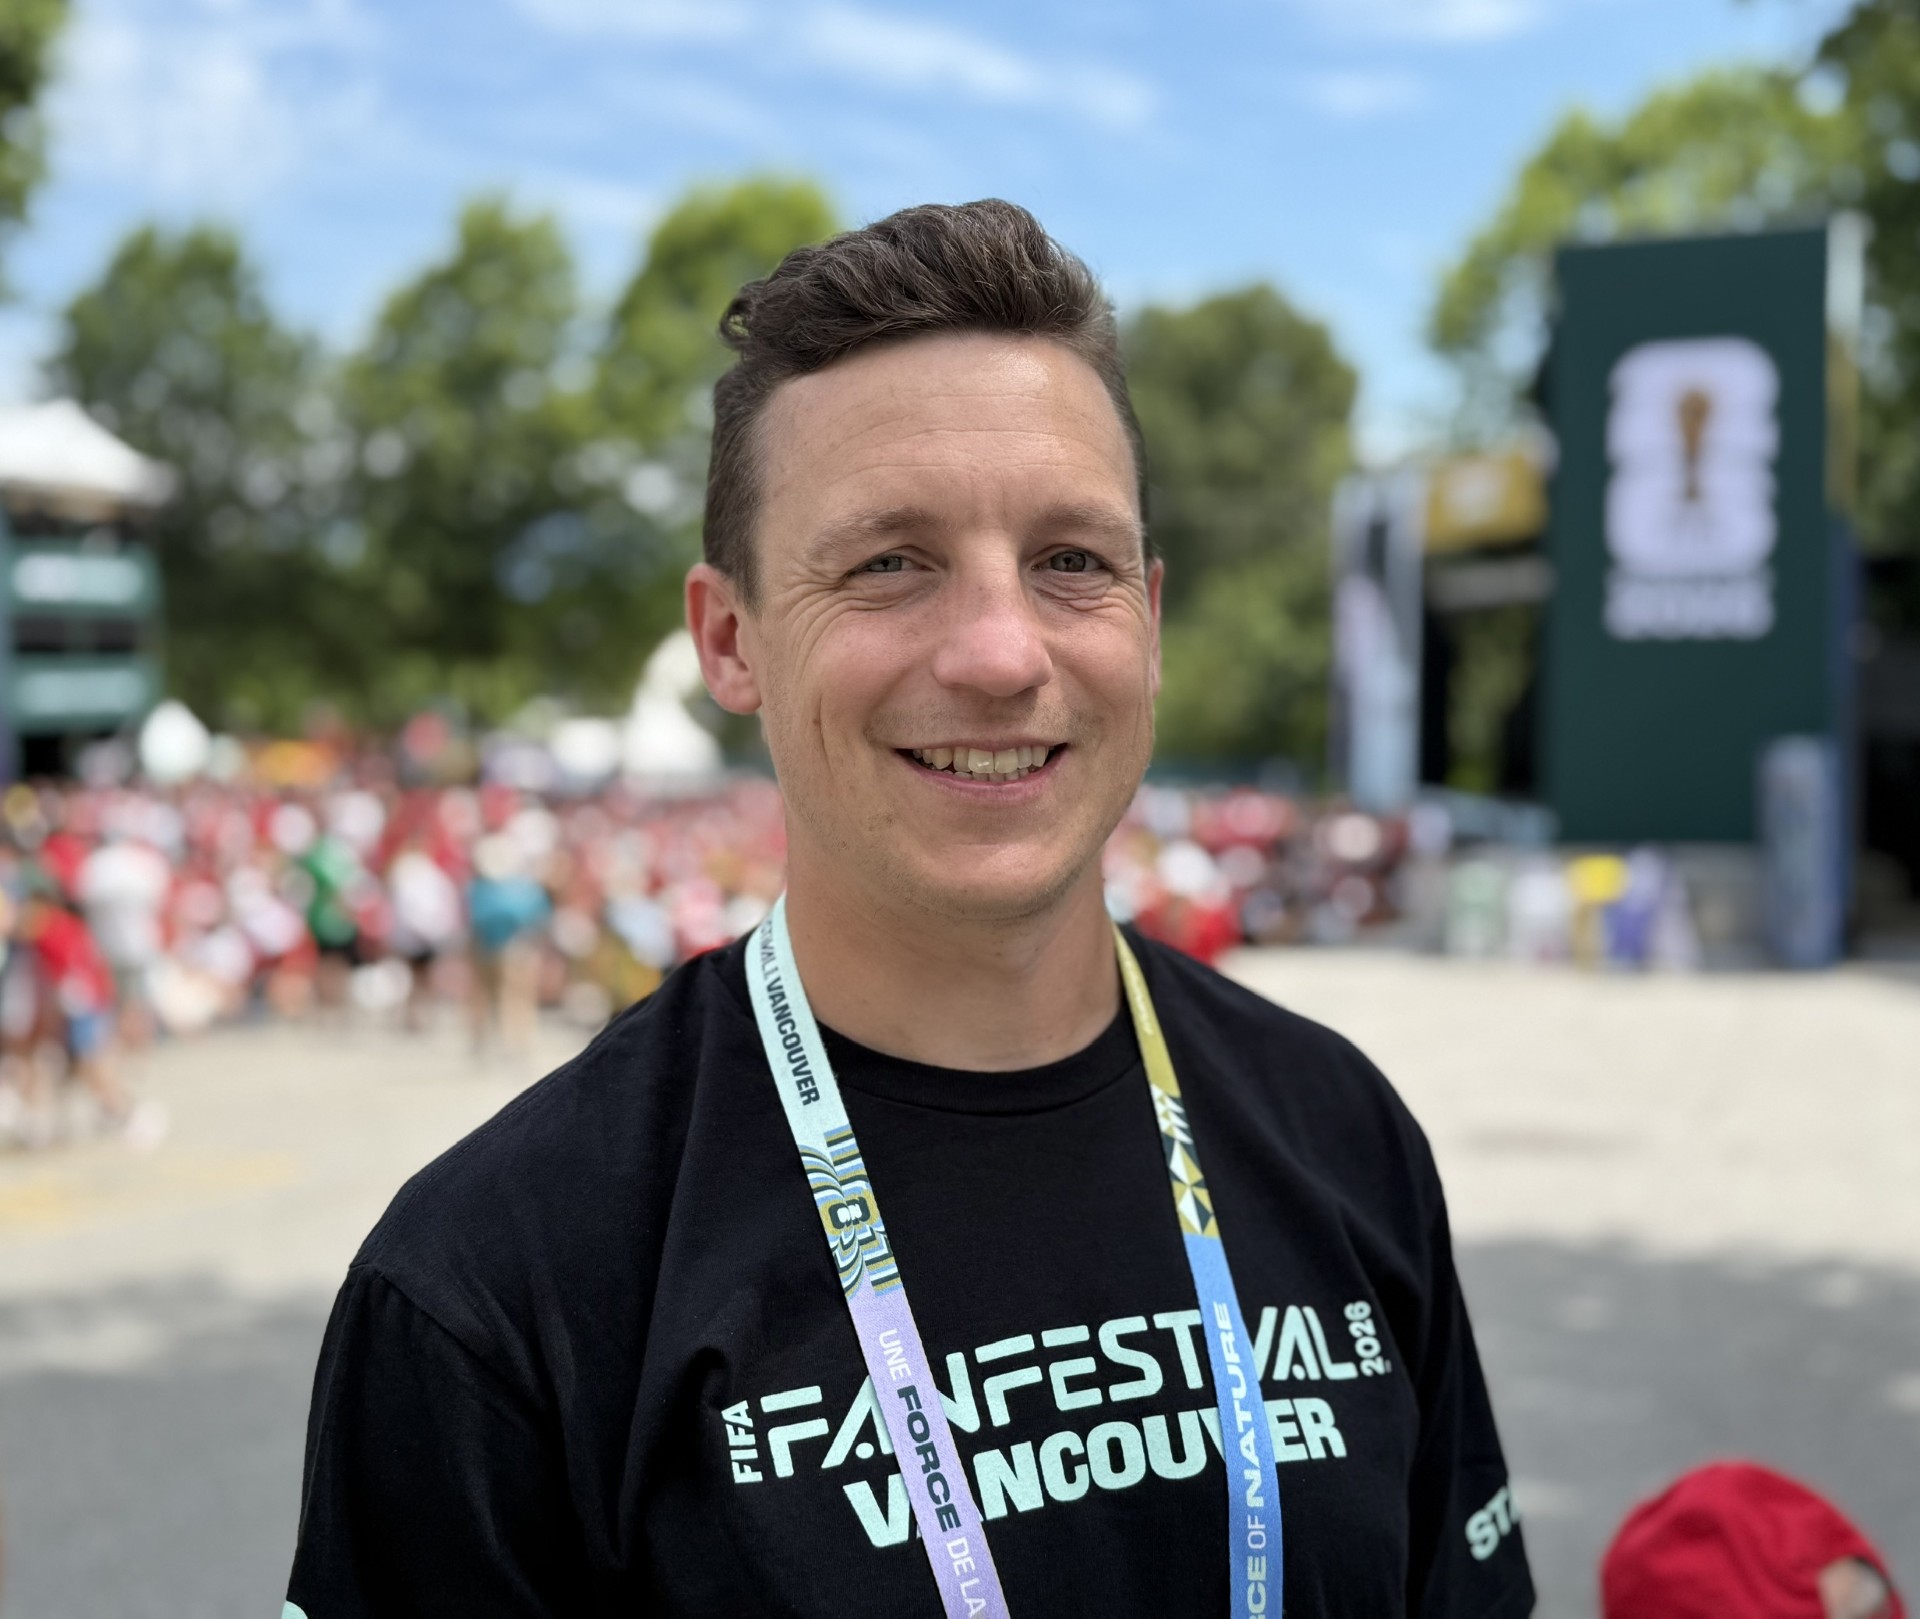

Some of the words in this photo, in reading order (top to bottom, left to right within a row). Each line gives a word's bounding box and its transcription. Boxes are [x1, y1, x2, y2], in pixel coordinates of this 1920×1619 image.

[766, 975, 821, 1106] VANCOUVER
[878, 1327, 912, 1382] UNE
[1343, 1300, 1386, 1377] 2026
[721, 1400, 764, 1484] FIFA
[1212, 1301, 1265, 1508] NATURE
[843, 1397, 1348, 1548] VNCOUER
[896, 1384, 962, 1532] FORCE
[946, 1537, 976, 1576] DE
[1246, 1514, 1267, 1549] OF
[960, 1577, 987, 1619] LA
[1246, 1555, 1267, 1619] CE
